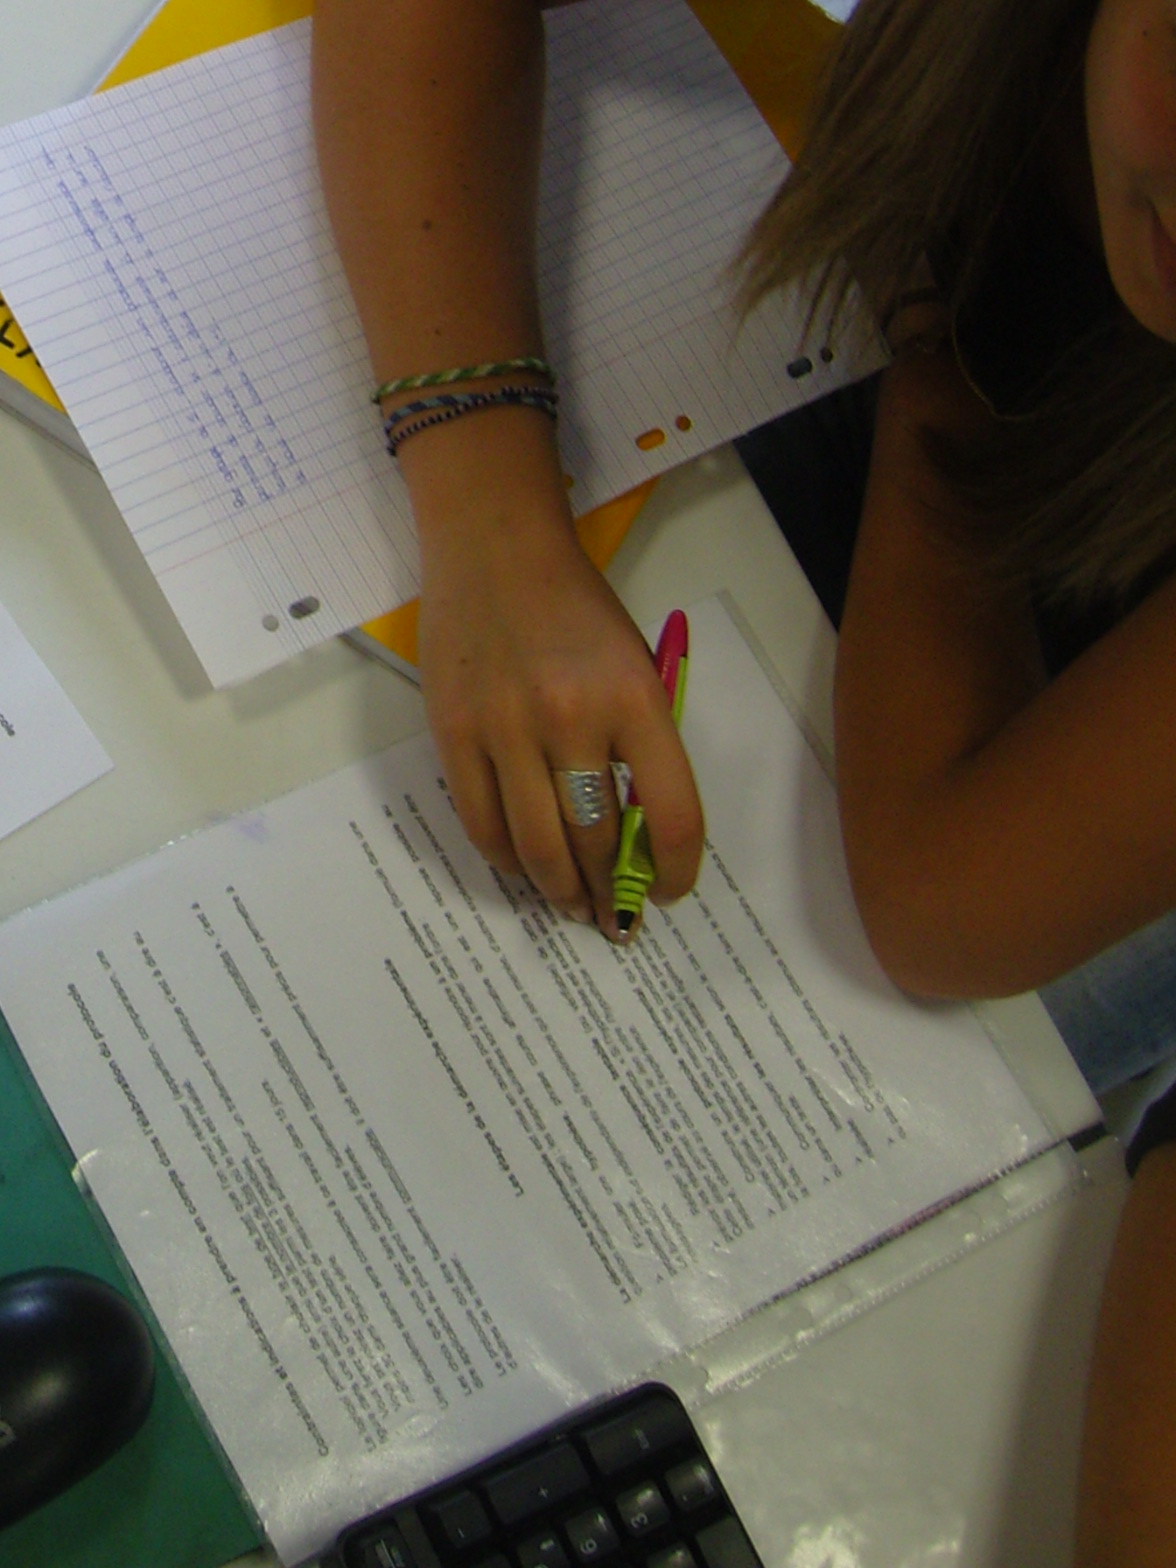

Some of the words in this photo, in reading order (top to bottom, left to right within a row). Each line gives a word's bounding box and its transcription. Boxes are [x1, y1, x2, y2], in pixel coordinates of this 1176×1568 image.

[65, 982, 104, 1041] protocole
[382, 957, 435, 1040] expérimentale
[430, 1040, 469, 1100] démarche
[149, 1135, 172, 1168] dans
[482, 1130, 511, 1172] étapes
[167, 1168, 198, 1216] compte
[506, 1172, 525, 1197] Les
[202, 1233, 237, 1285] prendre
[236, 1295, 280, 1366] indications
[283, 1381, 330, 1458] Contraintes
[630, 1512, 649, 1529] 3
[579, 1538, 599, 1555] 6
